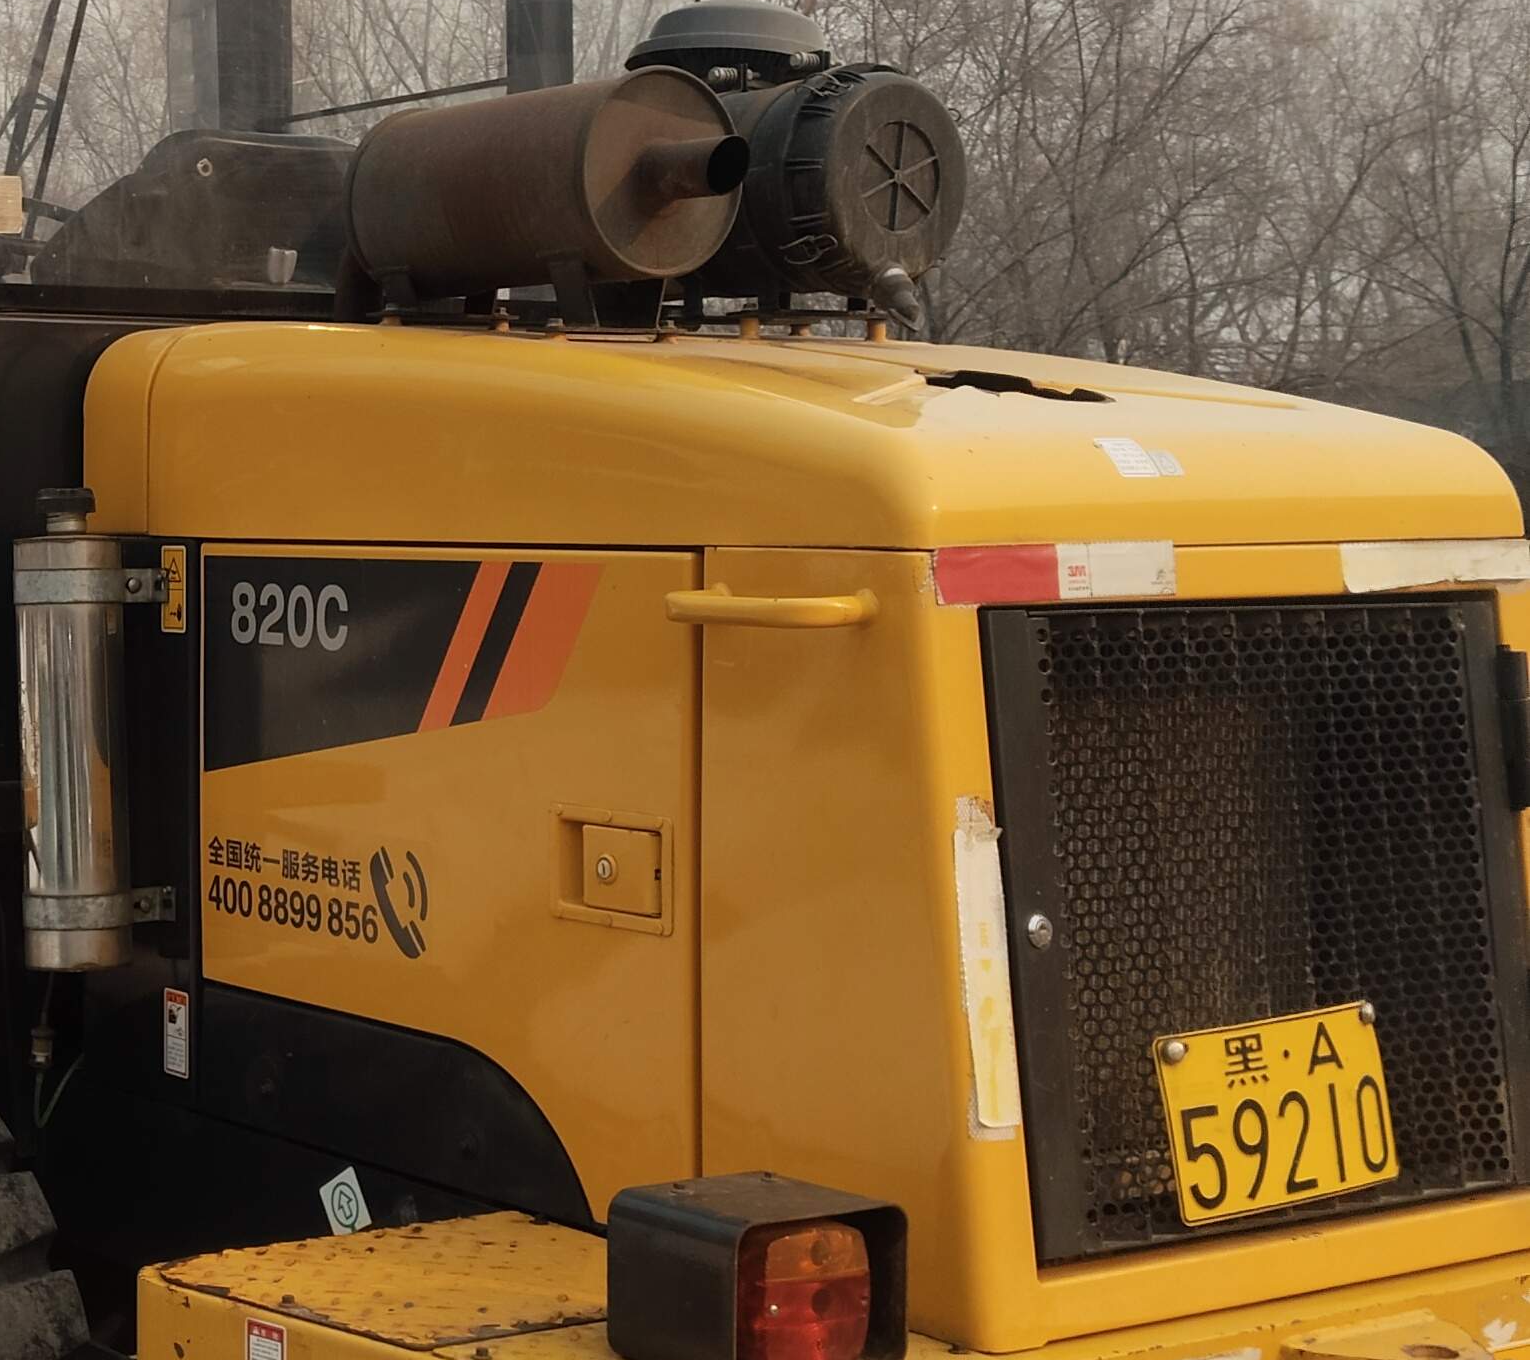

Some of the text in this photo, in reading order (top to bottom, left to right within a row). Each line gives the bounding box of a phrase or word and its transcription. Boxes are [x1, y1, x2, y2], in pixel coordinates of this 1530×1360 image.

[231, 581, 349, 652] 820C
[208, 836, 361, 893] 全国统一服务电话
[208, 874, 379, 944] 400 8899 856
[1180, 1074, 1389, 1210] 59210
